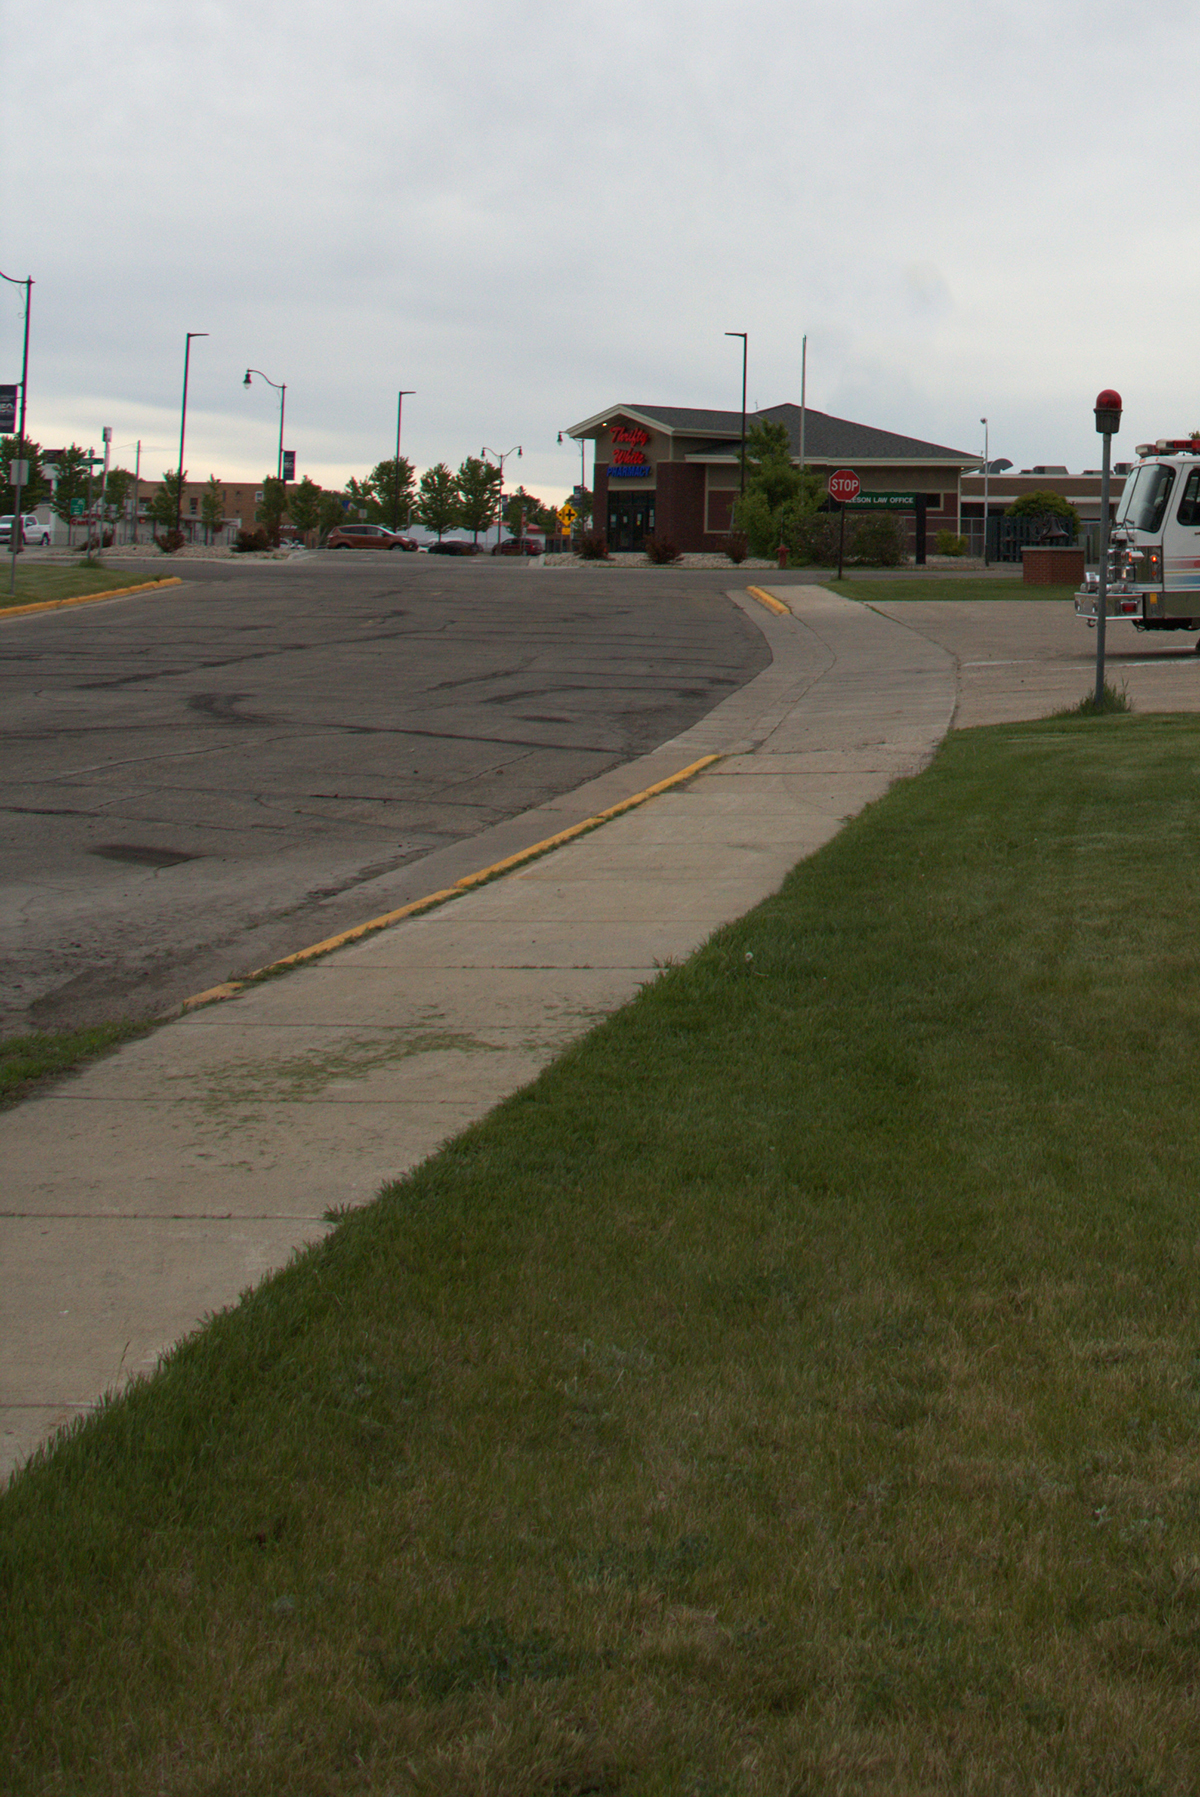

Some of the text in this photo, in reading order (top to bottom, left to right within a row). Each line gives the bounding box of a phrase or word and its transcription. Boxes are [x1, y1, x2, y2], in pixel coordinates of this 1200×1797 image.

[610, 426, 650, 447] Thrifty
[612, 448, 645, 464] White
[606, 466, 651, 477] PHARMACY
[831, 479, 859, 491] STOP
